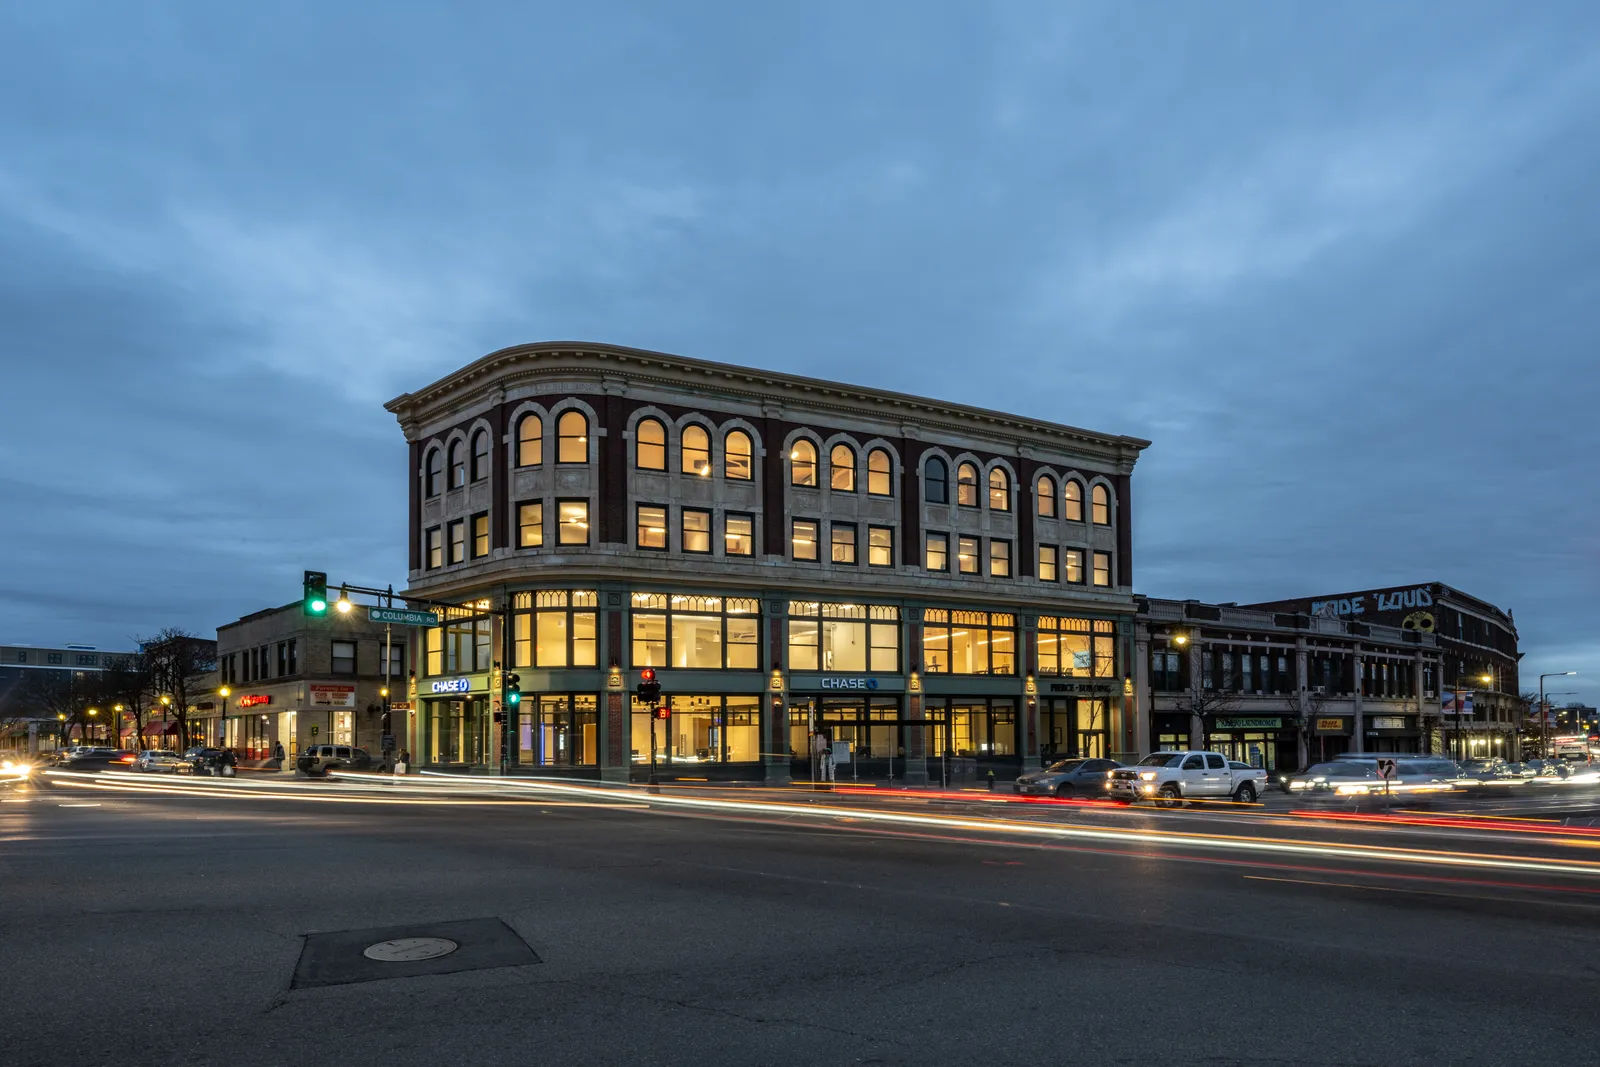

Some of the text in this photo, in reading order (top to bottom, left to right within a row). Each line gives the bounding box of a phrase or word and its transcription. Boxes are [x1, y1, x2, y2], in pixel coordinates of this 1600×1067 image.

[1377, 588, 1433, 611] LOUD
[382, 611, 422, 622] COLUMBIA
[432, 681, 459, 693] CHASE
[821, 678, 865, 689] CHASE
